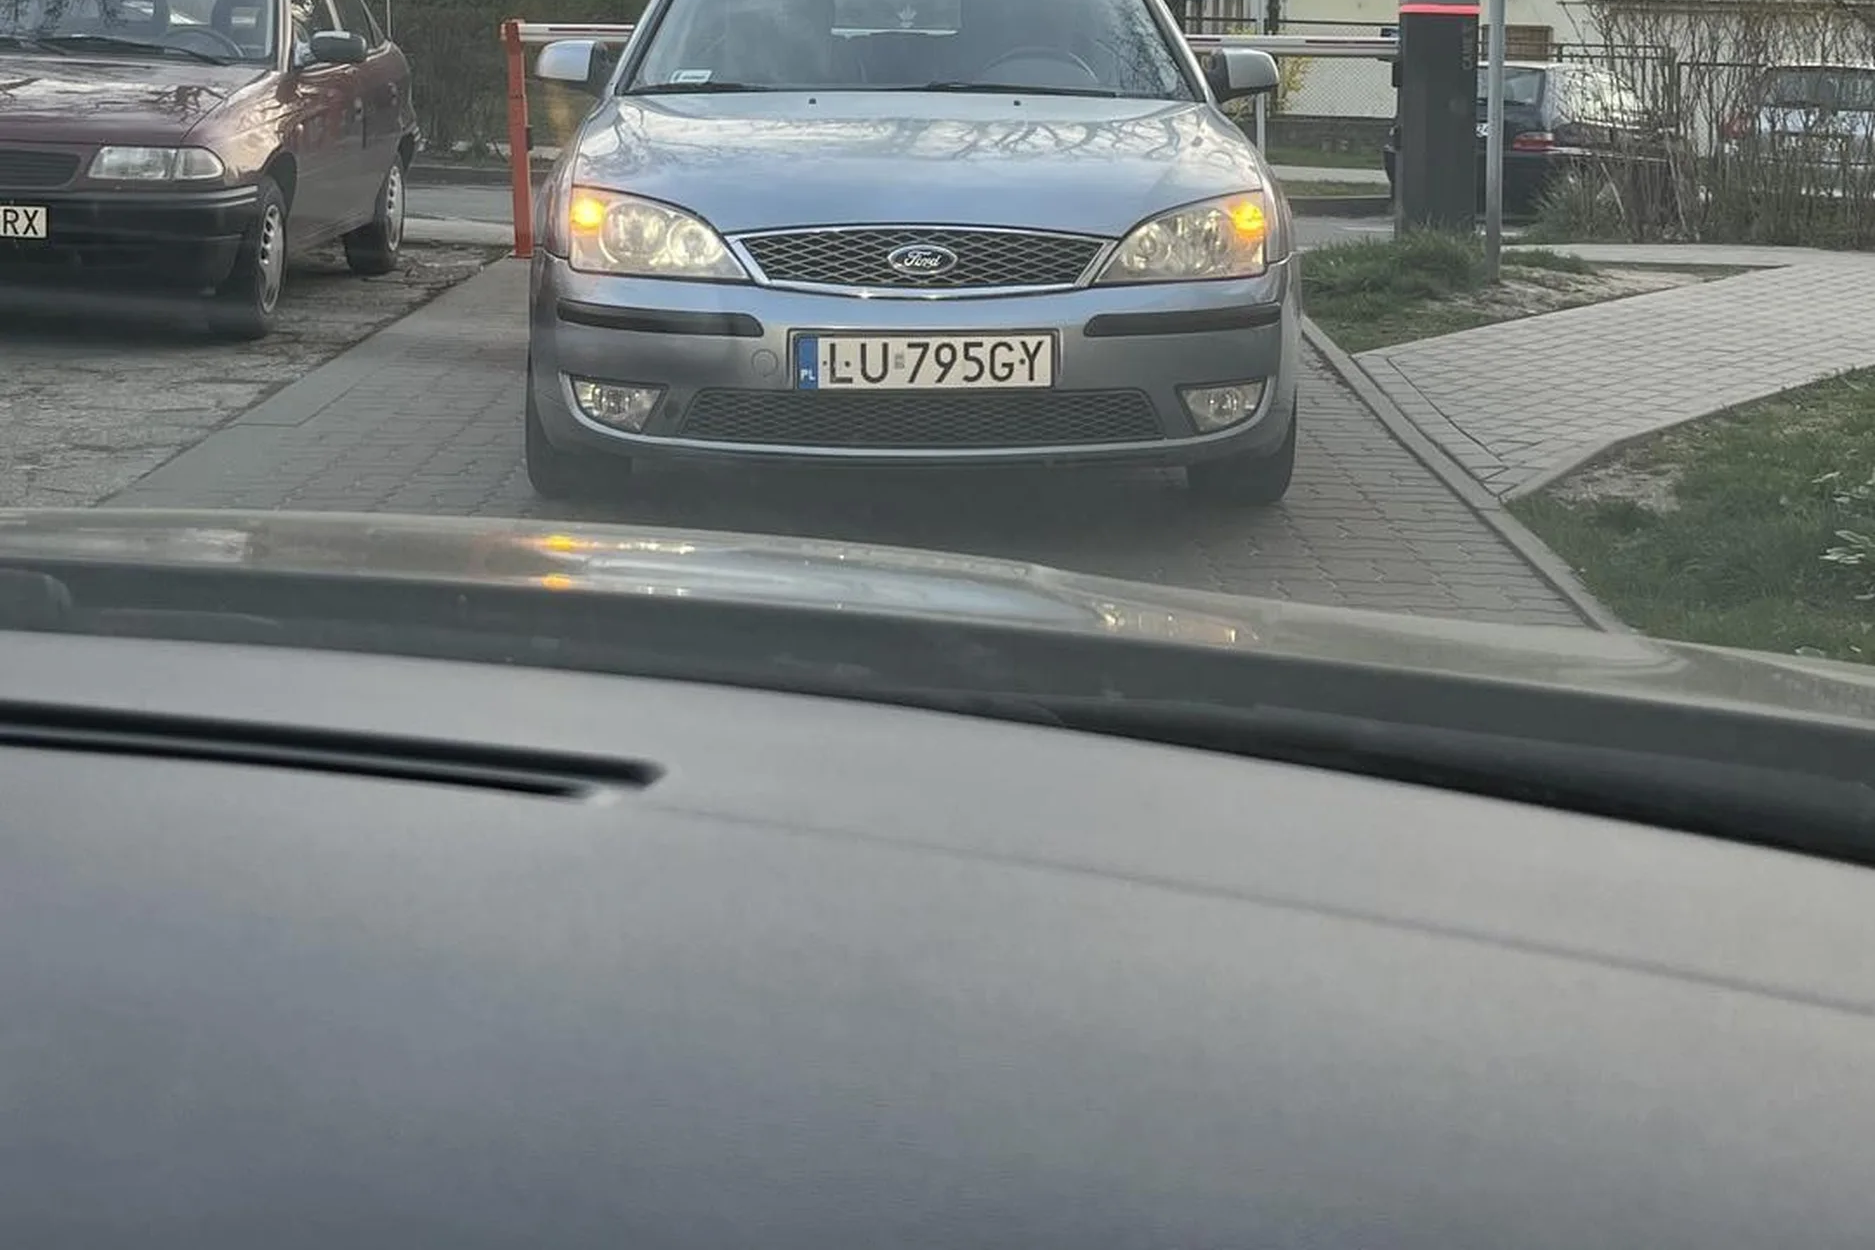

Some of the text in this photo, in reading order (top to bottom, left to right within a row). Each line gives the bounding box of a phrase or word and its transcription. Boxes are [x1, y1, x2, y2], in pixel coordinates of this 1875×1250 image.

[3, 209, 38, 235] RX
[904, 251, 942, 268] Ford
[829, 340, 1044, 384] LU 795GY
[800, 369, 816, 381] PL
